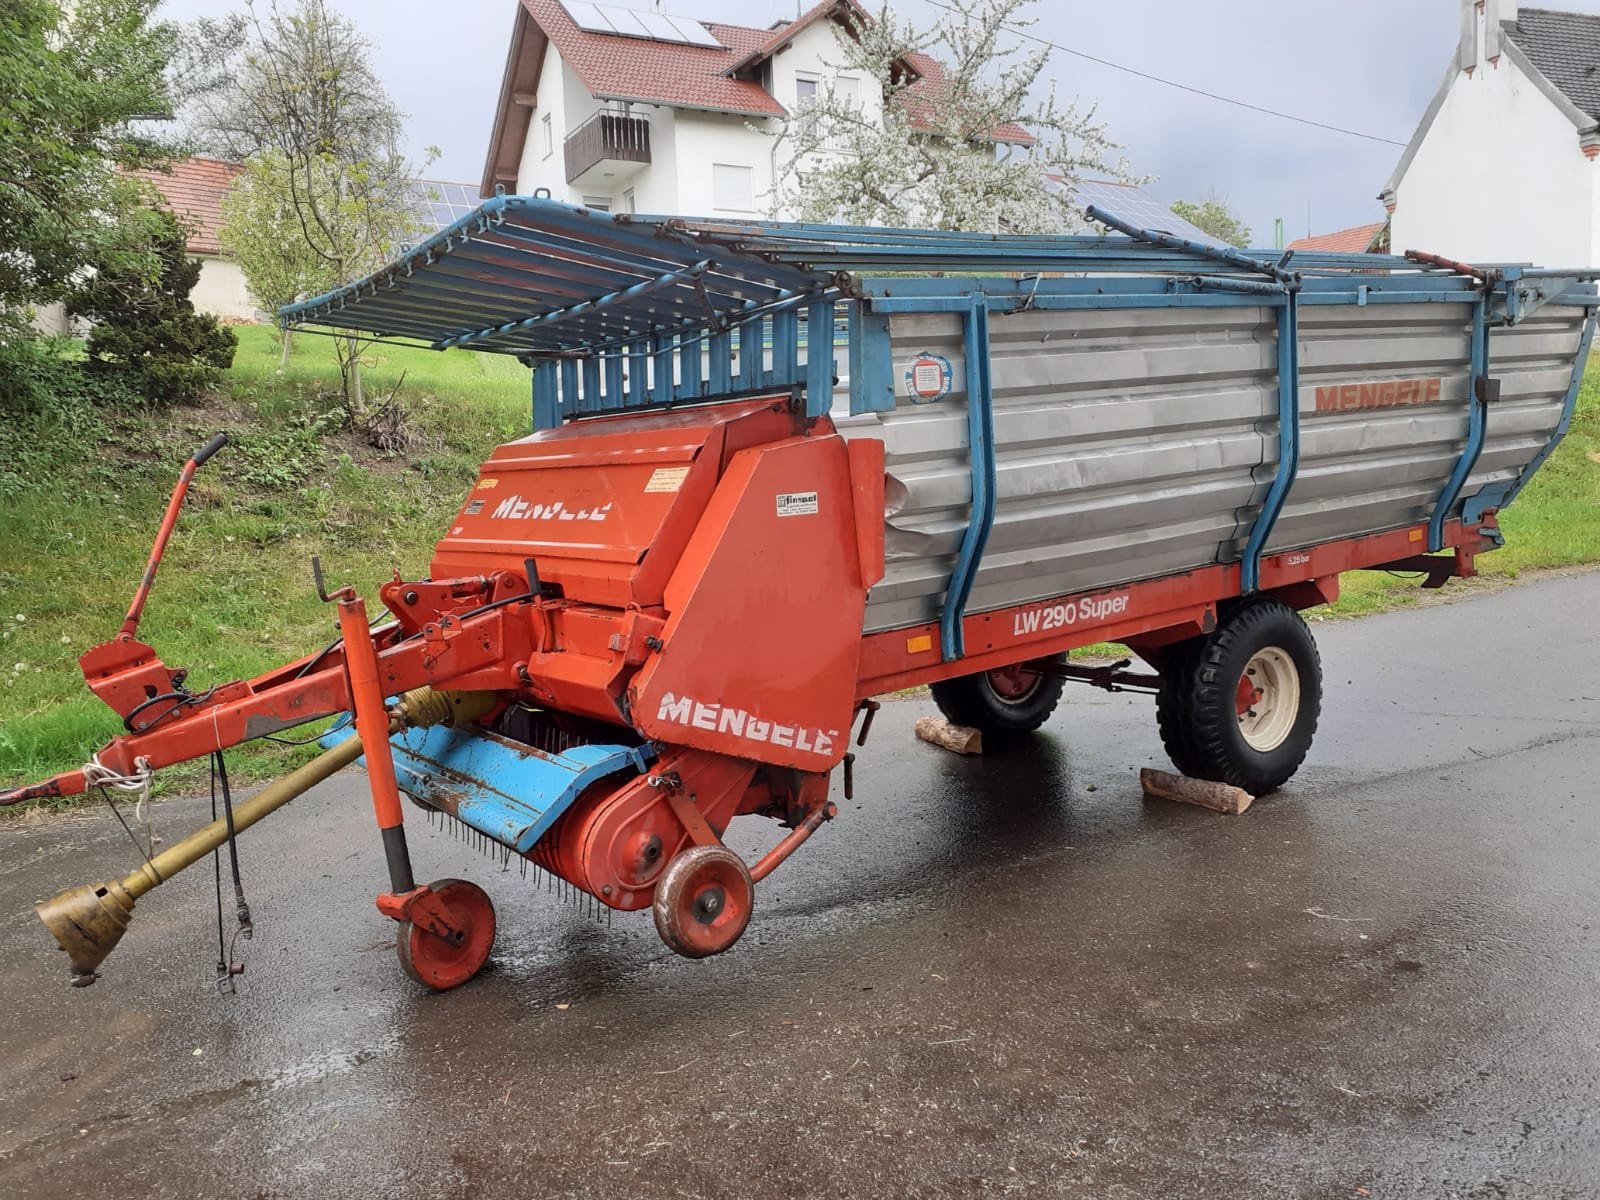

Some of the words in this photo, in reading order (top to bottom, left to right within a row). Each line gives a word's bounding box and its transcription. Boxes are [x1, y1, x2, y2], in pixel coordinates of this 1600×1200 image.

[1315, 377, 1441, 412] MENGELE
[1013, 609, 1042, 636] LW
[1042, 603, 1076, 630] 290
[1078, 595, 1129, 620] Super
[657, 691, 839, 756] MENGELE
